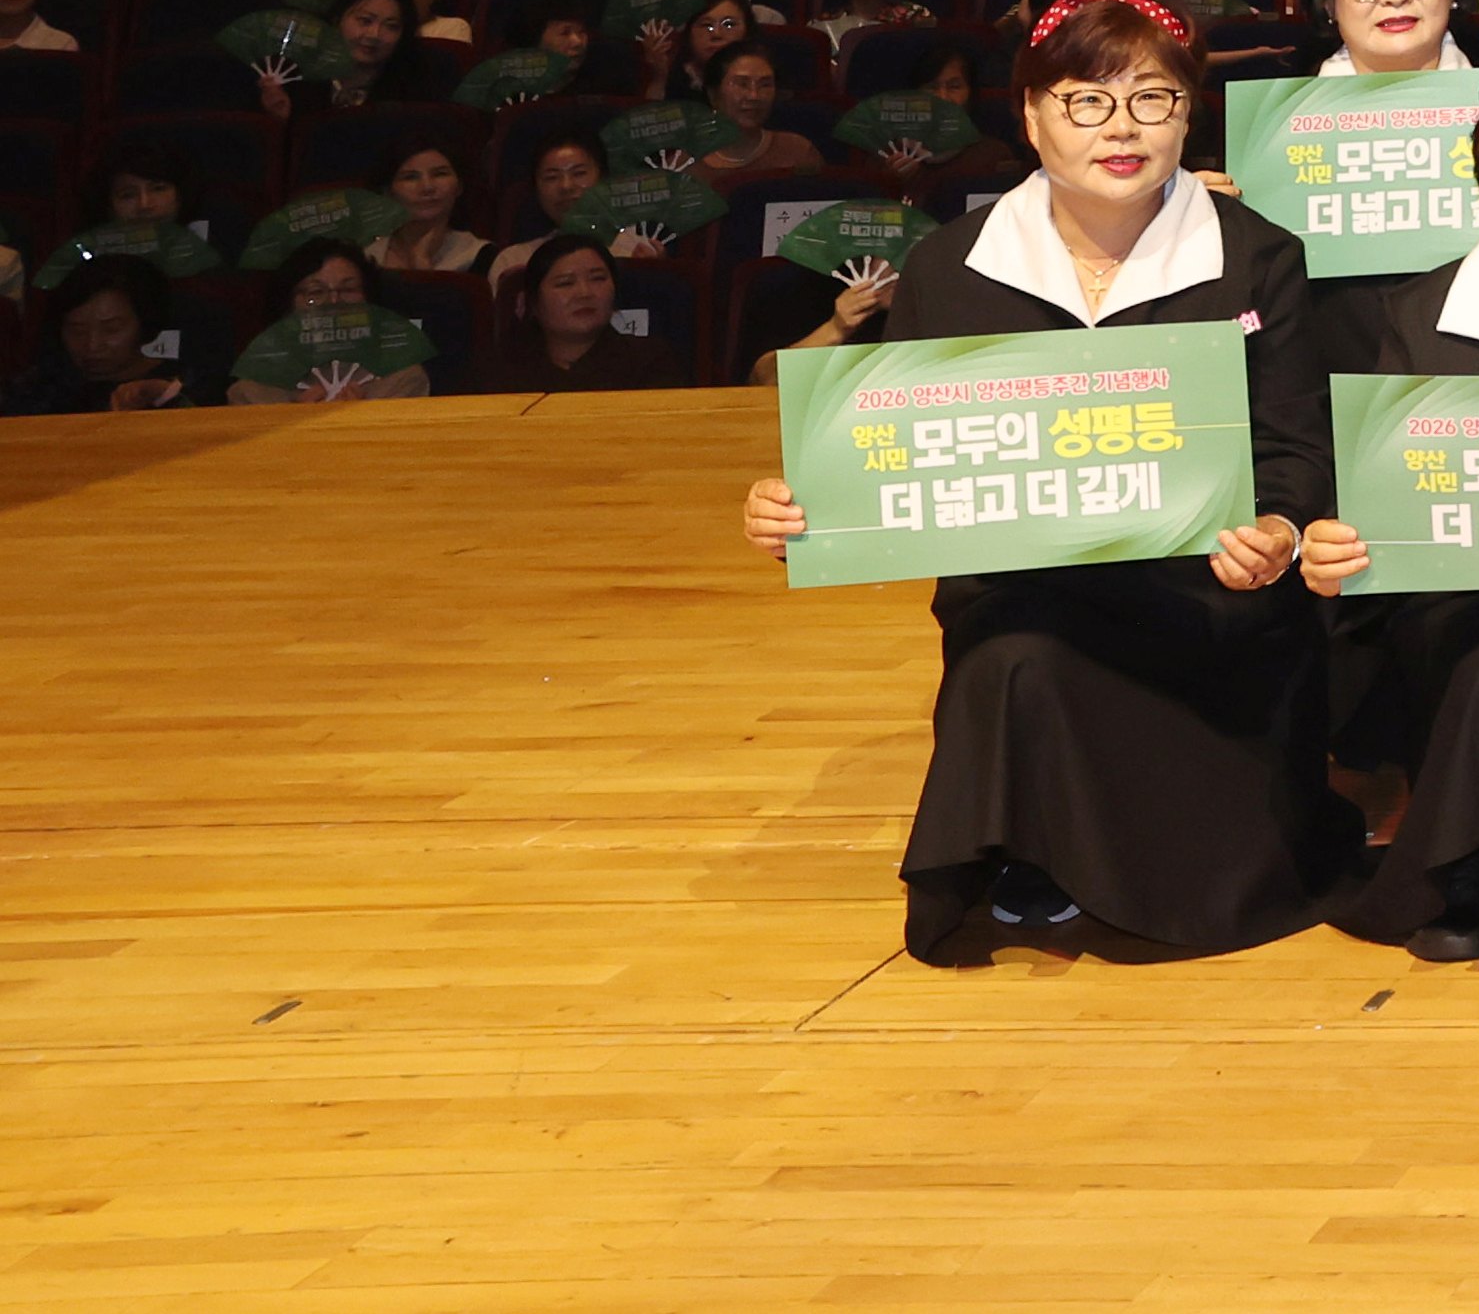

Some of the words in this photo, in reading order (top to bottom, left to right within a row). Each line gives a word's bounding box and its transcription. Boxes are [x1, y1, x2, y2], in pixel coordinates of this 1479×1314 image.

[1336, 137, 1441, 183] 모두의
[1305, 193, 1342, 236] 더
[1351, 189, 1421, 234] 넓고
[1428, 187, 1463, 230] 더
[856, 389, 909, 411] 2026
[912, 384, 972, 408] 양산시
[975, 373, 1090, 402] 양성평등주간
[1096, 368, 1169, 391] 기념행사
[913, 411, 1040, 468] 모두의
[1048, 401, 1185, 459] 성평등,
[1407, 418, 1459, 438] 2026
[880, 481, 924, 531] 더
[932, 473, 1019, 528] 넓고
[1025, 469, 1069, 518] 더
[1076, 462, 1162, 515] 깊게
[1431, 503, 1473, 547] 더
